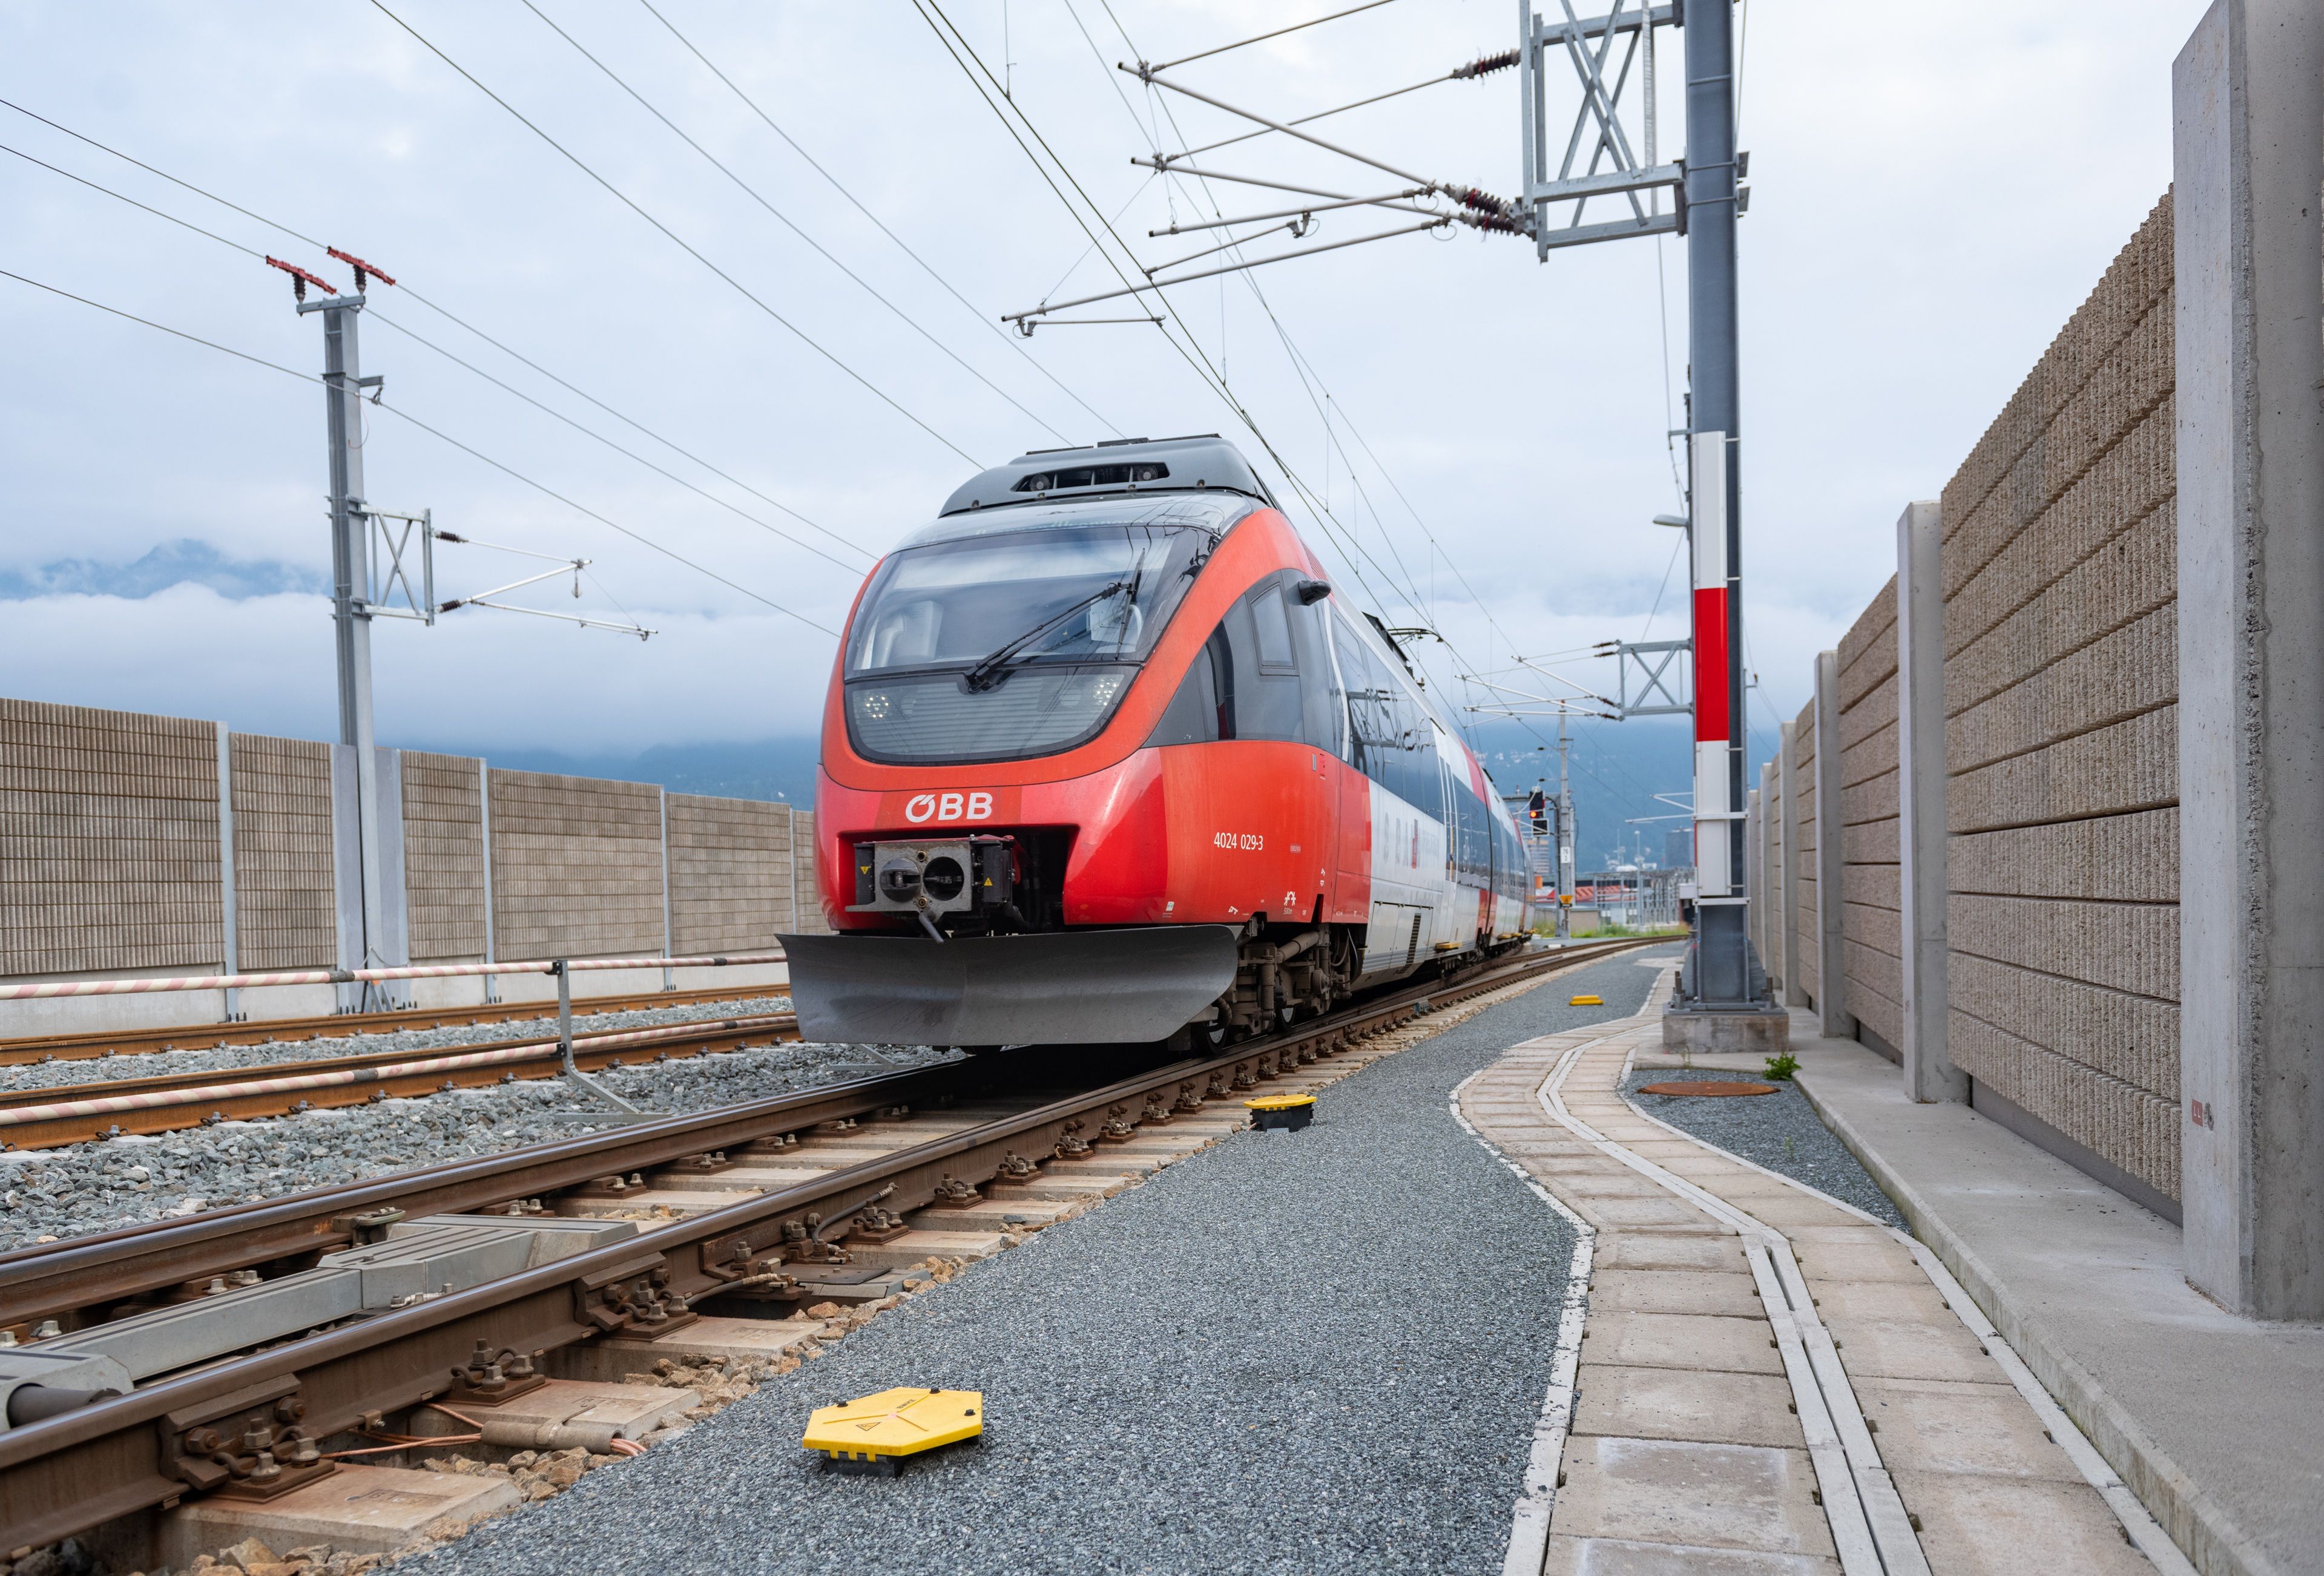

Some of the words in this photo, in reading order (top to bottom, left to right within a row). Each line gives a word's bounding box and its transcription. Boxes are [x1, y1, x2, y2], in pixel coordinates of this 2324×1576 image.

[905, 792, 993, 823] ÖBB
[1214, 832, 1237, 849] 4024
[1240, 834, 1263, 851] 029-3
